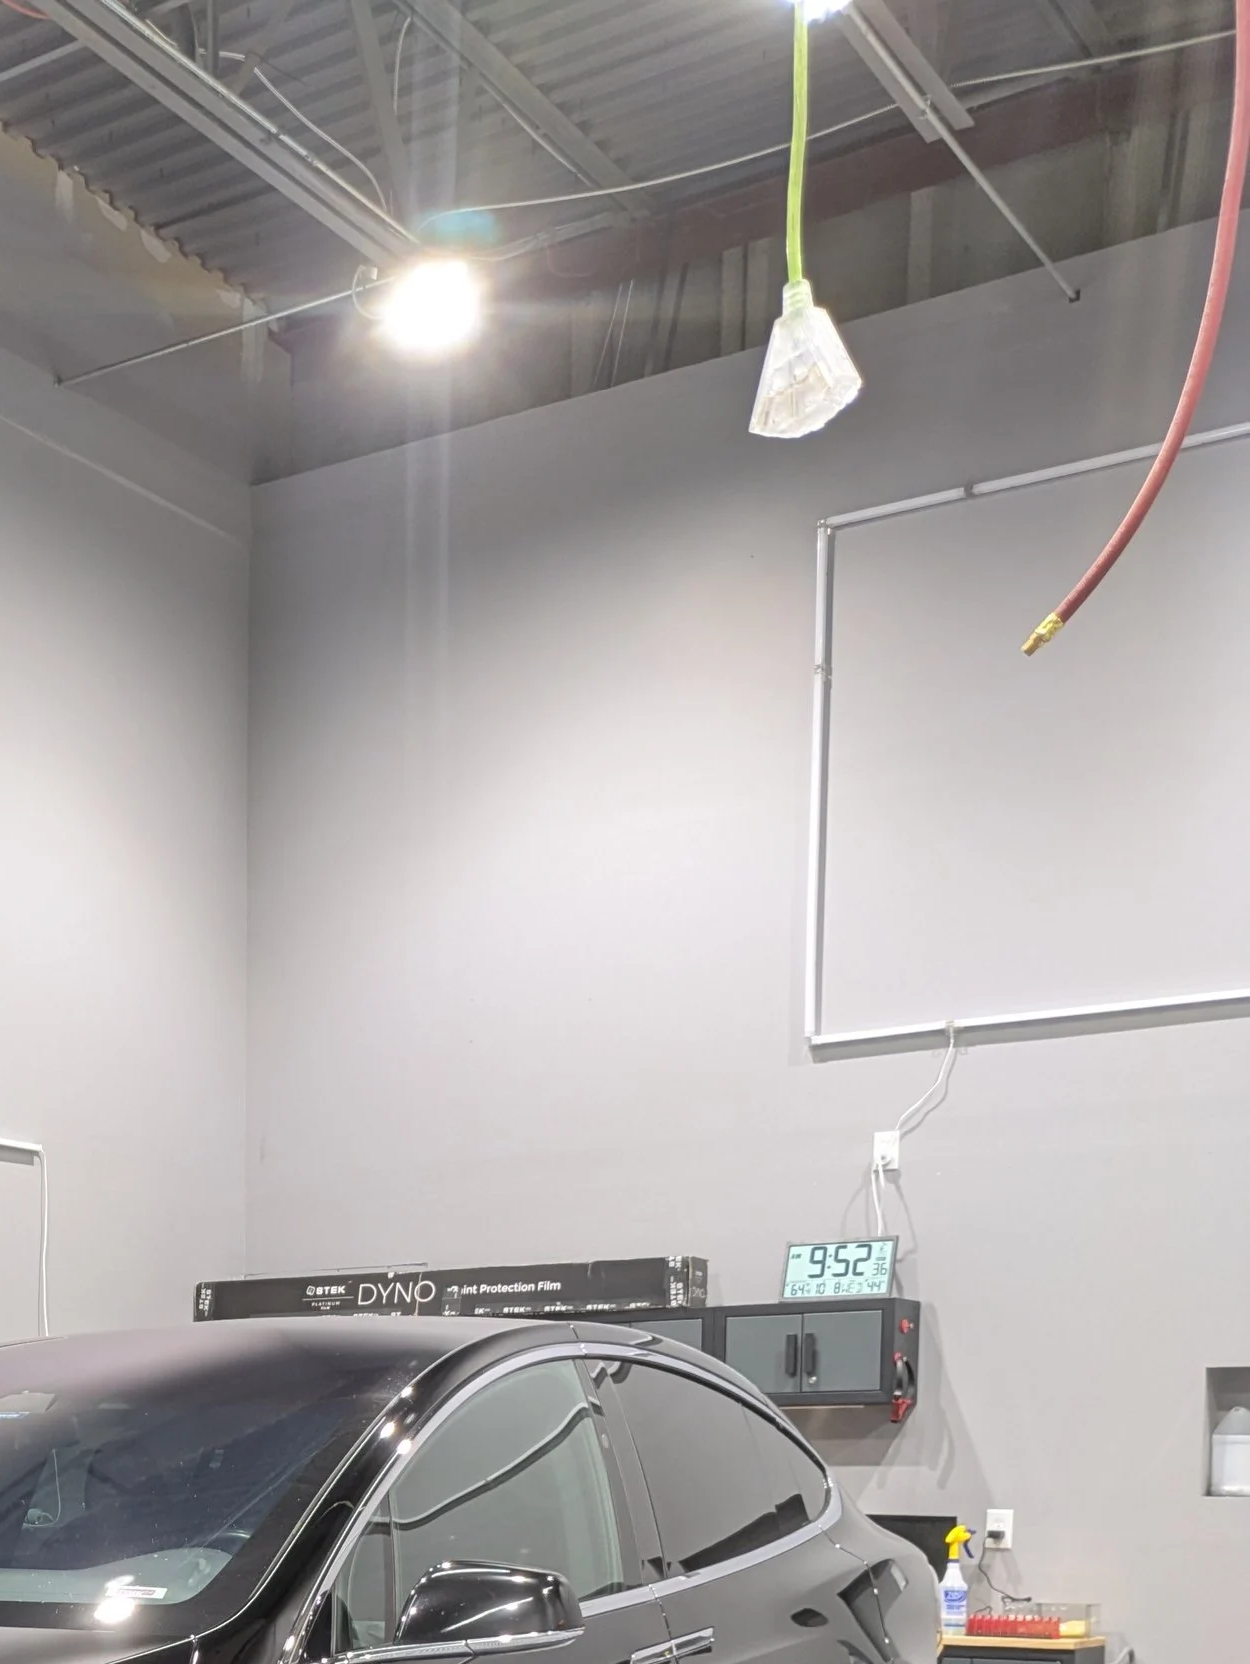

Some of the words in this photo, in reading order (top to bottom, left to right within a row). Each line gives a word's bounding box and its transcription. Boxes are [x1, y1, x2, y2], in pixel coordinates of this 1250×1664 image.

[807, 1244, 872, 1278] 9:52
[871, 1262, 888, 1276] 36
[316, 1285, 346, 1296] STEK
[358, 1280, 436, 1306] DYNO
[479, 1281, 535, 1295] Protection
[537, 1280, 561, 1292] Film
